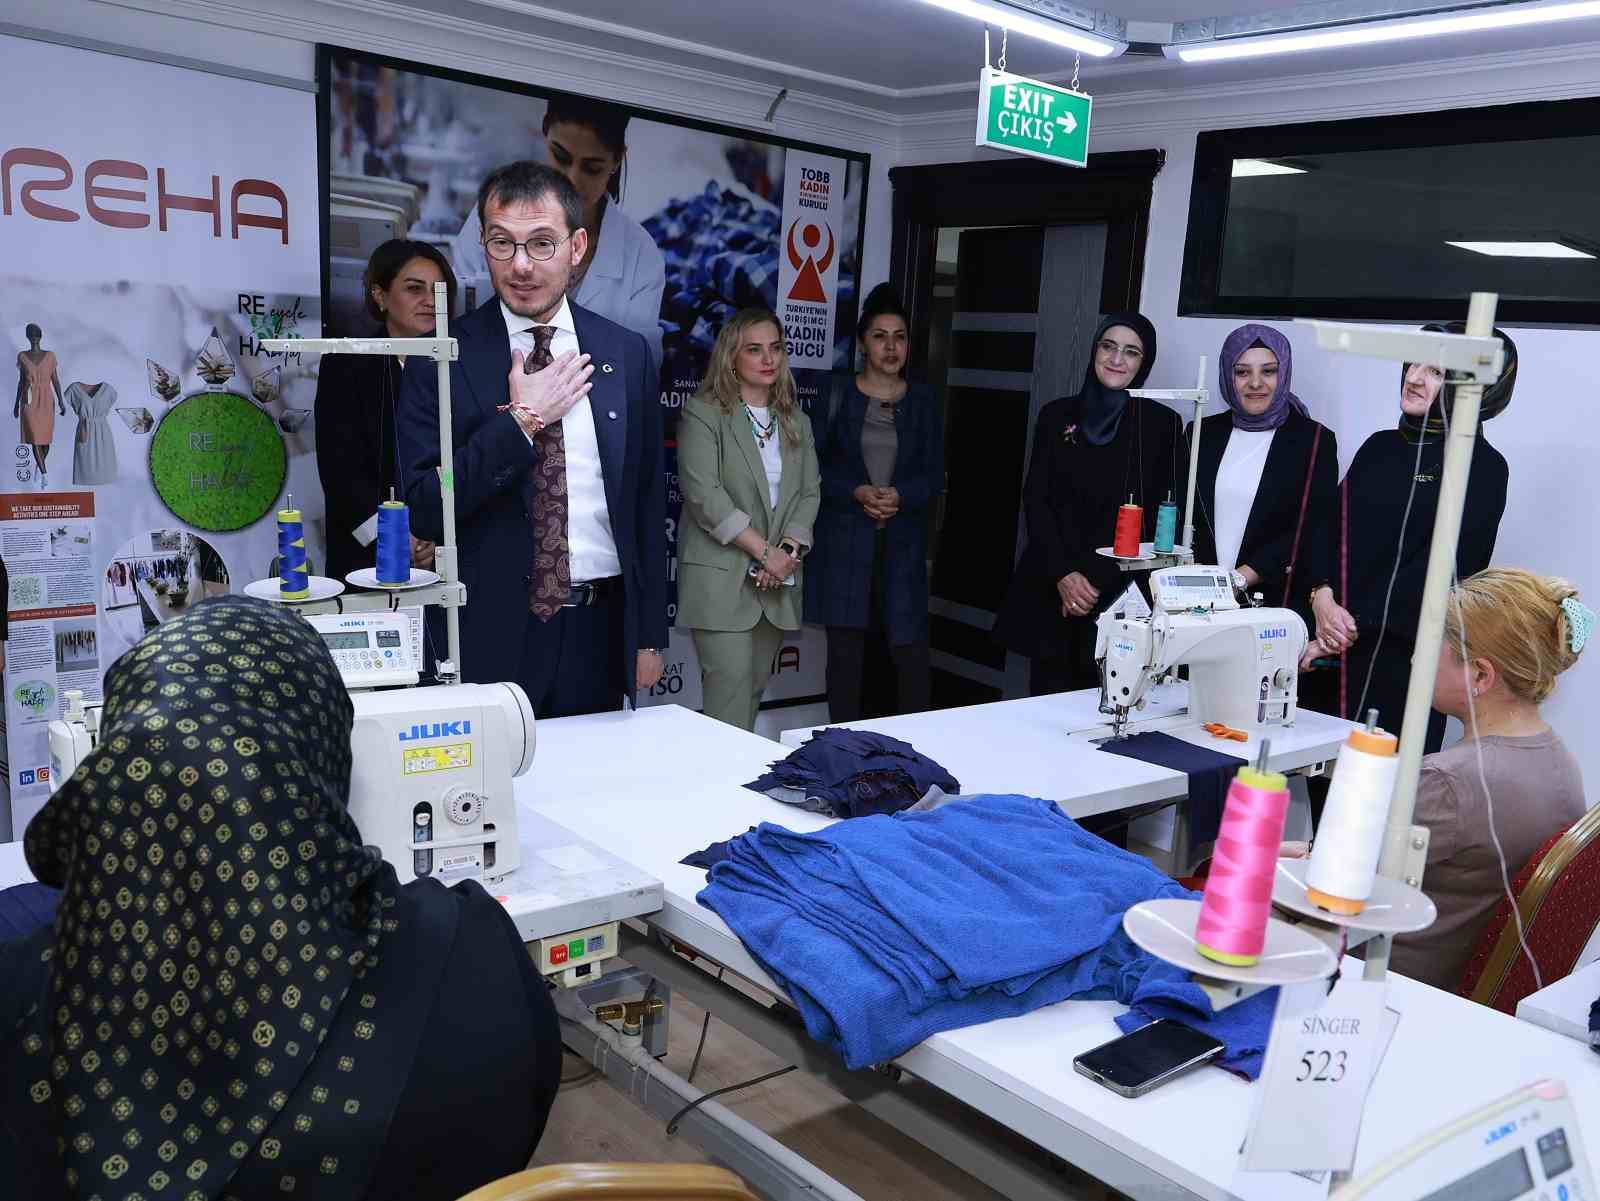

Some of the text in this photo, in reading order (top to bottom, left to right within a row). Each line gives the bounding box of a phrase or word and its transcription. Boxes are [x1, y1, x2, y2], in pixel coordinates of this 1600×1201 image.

[1004, 83, 1054, 118] EXIT
[998, 110, 1054, 149] ÇIKIŞ
[801, 167, 830, 184] TOBB
[1, 147, 289, 245] REHA
[800, 180, 829, 194] KADIN
[799, 198, 828, 210] KURULU
[238, 294, 265, 315] RE
[784, 325, 826, 342] KADIN
[1260, 628, 1287, 639] JUKI
[399, 720, 471, 741] JUKI
[1301, 1015, 1361, 1035] SİNGER
[1296, 1050, 1348, 1082] 523
